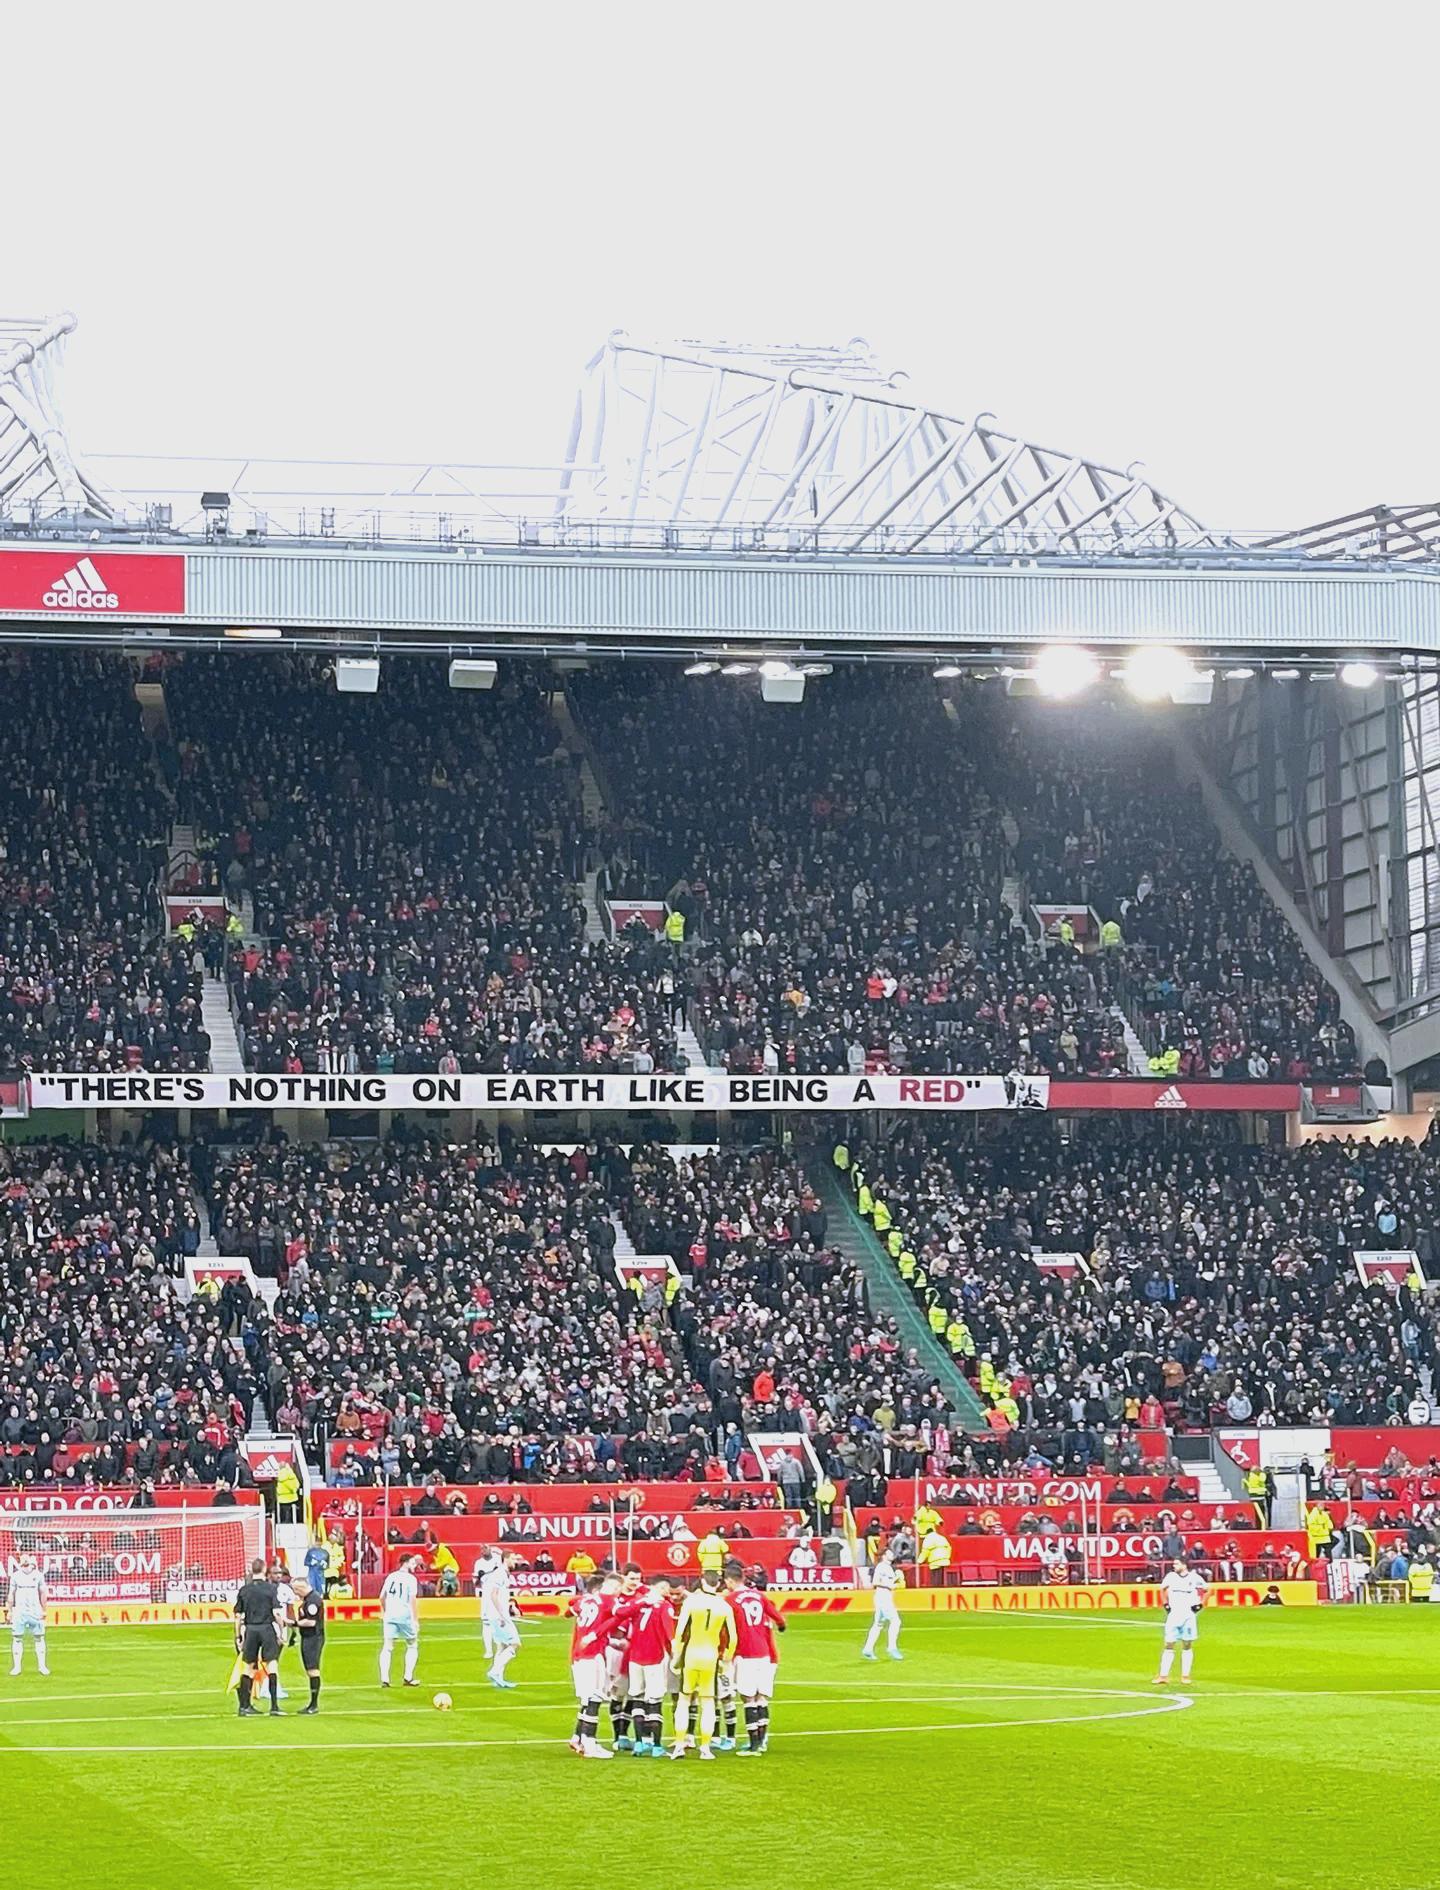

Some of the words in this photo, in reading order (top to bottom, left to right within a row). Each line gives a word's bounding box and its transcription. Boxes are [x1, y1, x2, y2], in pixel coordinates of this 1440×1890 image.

[42, 588, 119, 609] adidas
[39, 1078, 205, 1102] "THERE'S
[229, 1078, 387, 1102] NOTHING
[415, 1078, 462, 1102] ON
[487, 1078, 604, 1102] EARTH
[629, 1079, 704, 1103] LIKE
[729, 1079, 829, 1103] BEING
[852, 1079, 876, 1103] A
[899, 1079, 981, 1103] RED"
[389, 1581, 403, 1599] 41
[507, 1573, 567, 1586] ASGOW
[188, 1592, 227, 1604] REDS
[121, 1606, 230, 1623] MUND
[640, 1608, 653, 1631] 7
[705, 1608, 711, 1631] 1
[741, 1600, 763, 1626] 19
